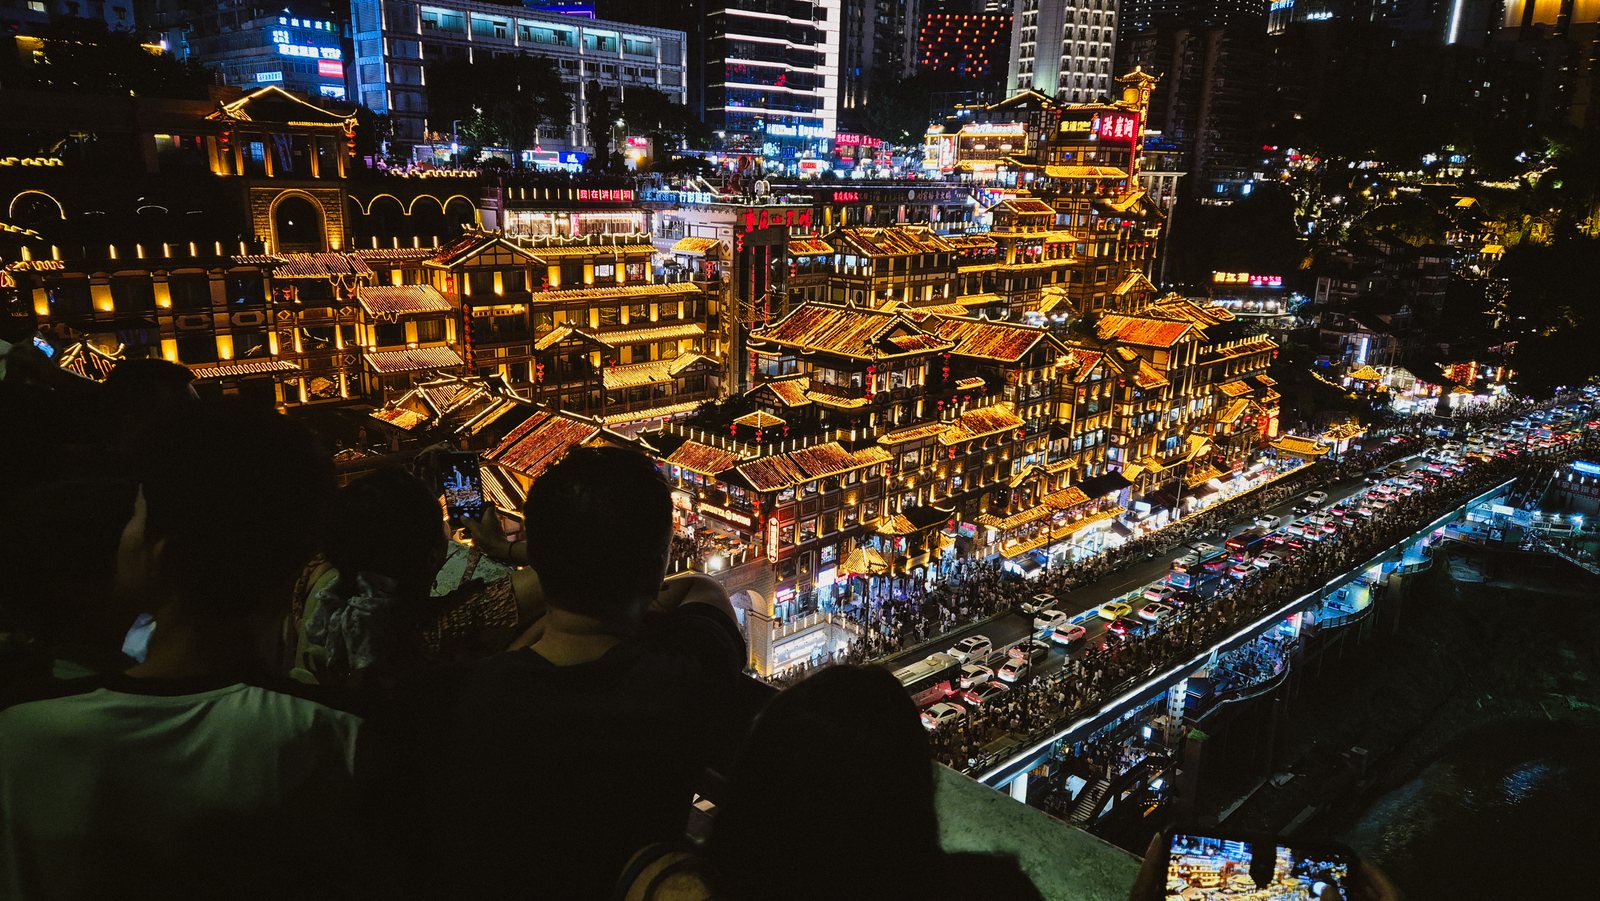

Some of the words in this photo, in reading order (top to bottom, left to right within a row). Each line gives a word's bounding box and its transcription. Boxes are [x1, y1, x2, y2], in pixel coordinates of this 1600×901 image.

[1102, 115, 1134, 138] 洪崖洞
[580, 189, 631, 199] 我在洪崖洞
